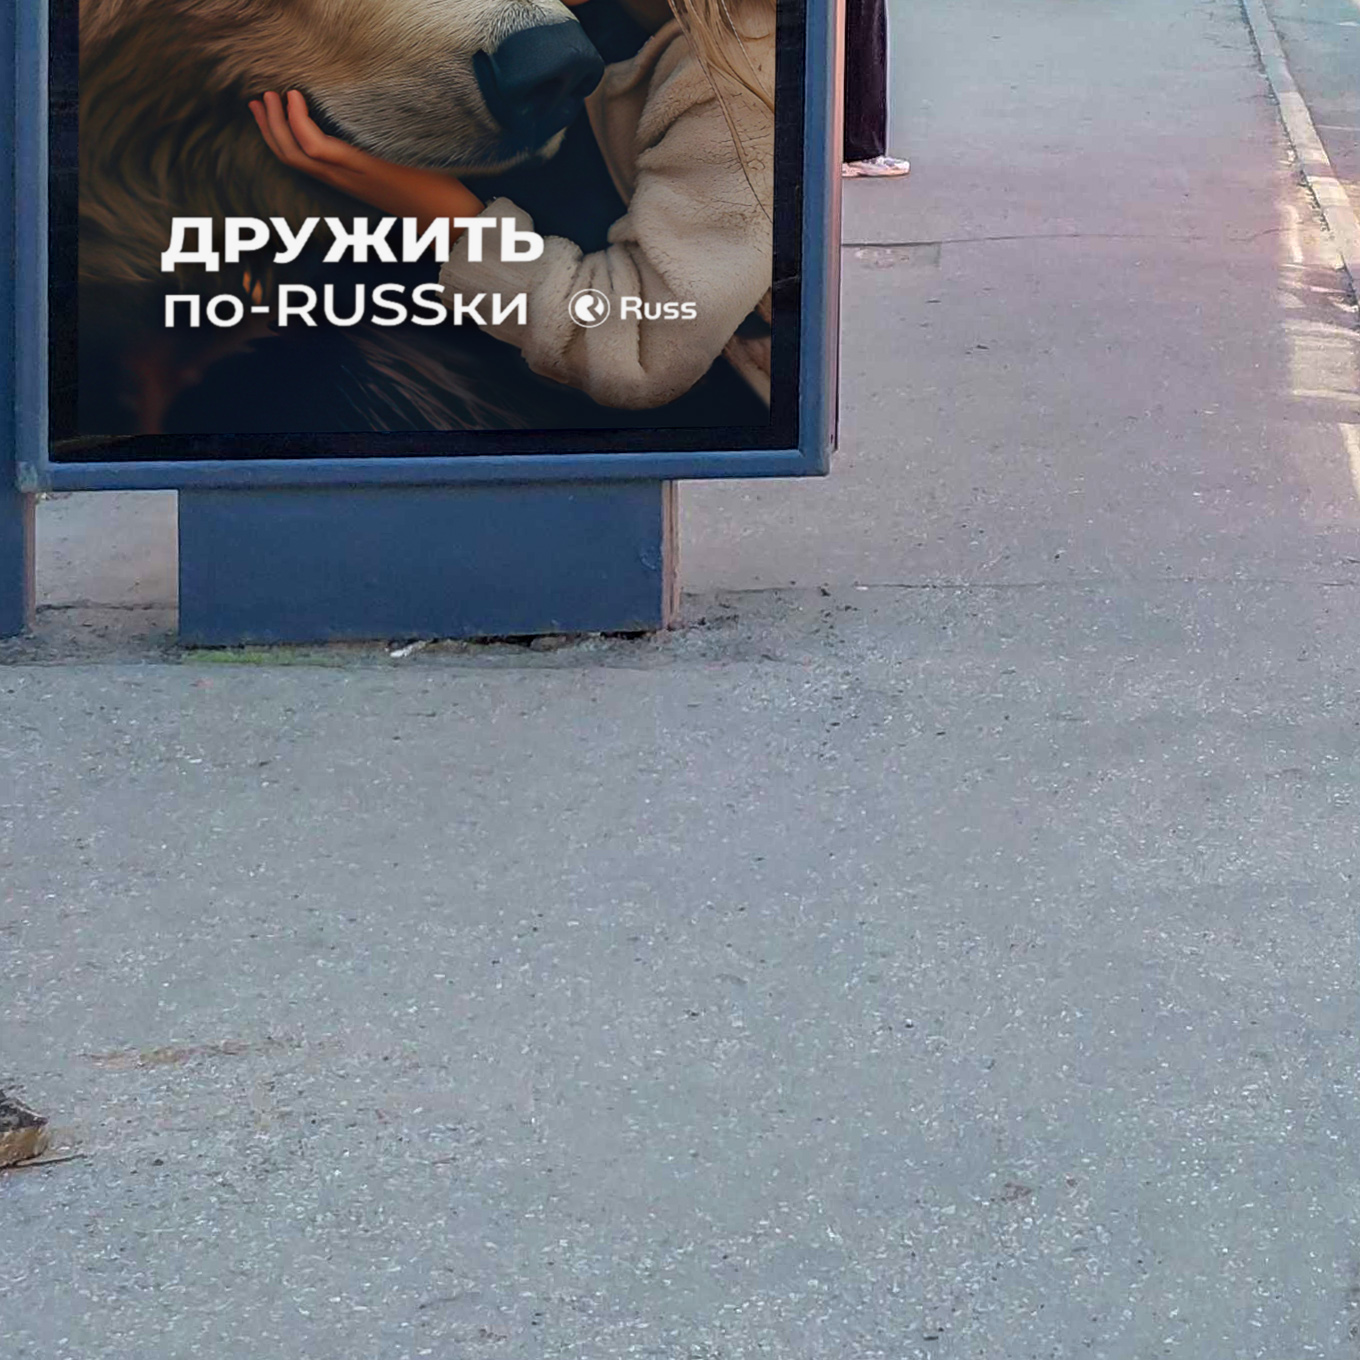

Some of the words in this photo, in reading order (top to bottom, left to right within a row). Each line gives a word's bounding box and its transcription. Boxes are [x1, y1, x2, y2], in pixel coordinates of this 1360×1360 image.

[161, 216, 545, 272] ДРУЖИТЬ
[164, 283, 527, 328] по-RUSSки
[619, 294, 698, 321] Russ
